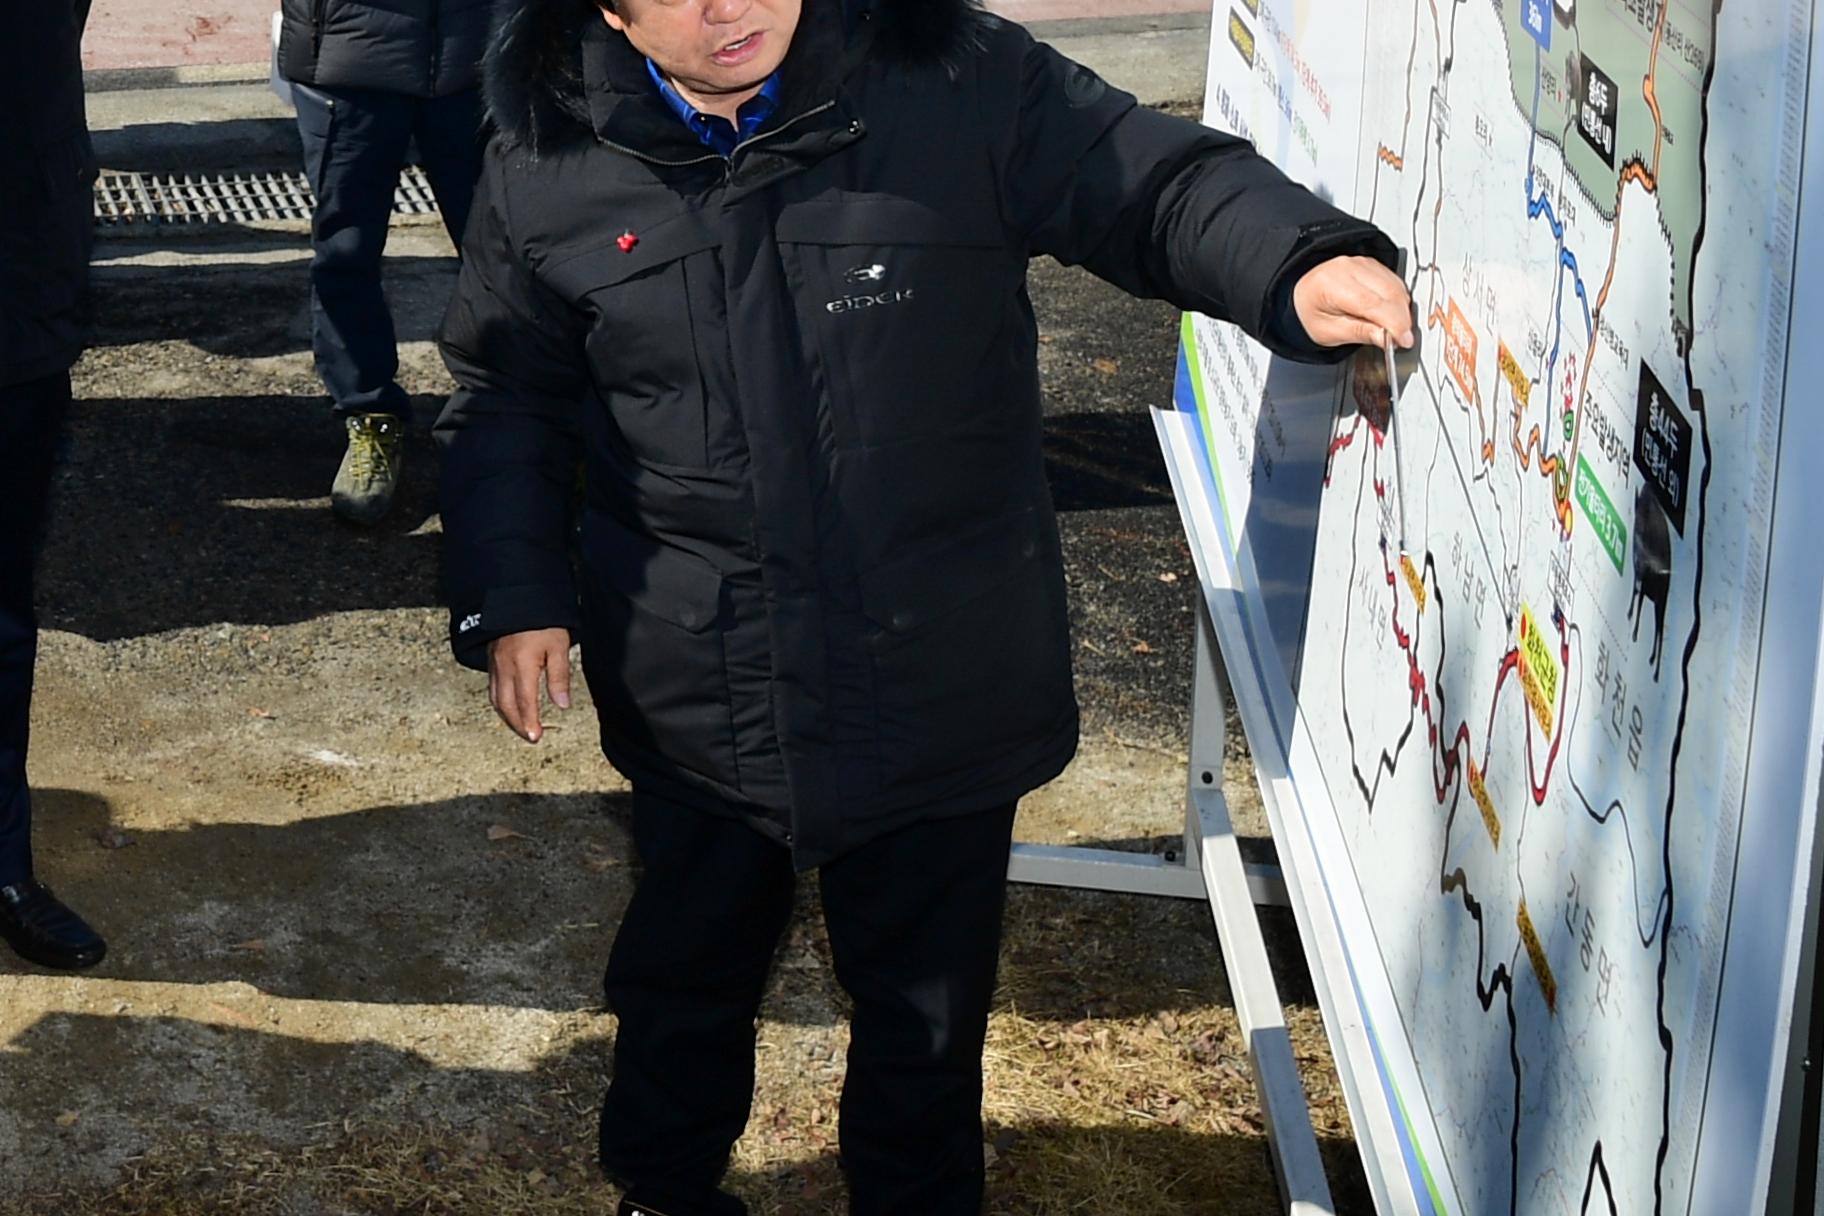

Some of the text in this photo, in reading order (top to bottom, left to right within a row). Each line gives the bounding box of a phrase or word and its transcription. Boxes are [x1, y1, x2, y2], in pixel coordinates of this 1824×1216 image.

[1584, 390, 1631, 489] 주요발생지역
[1595, 639, 1643, 772] 화천읍
[1565, 870, 1618, 1016] 간동면
